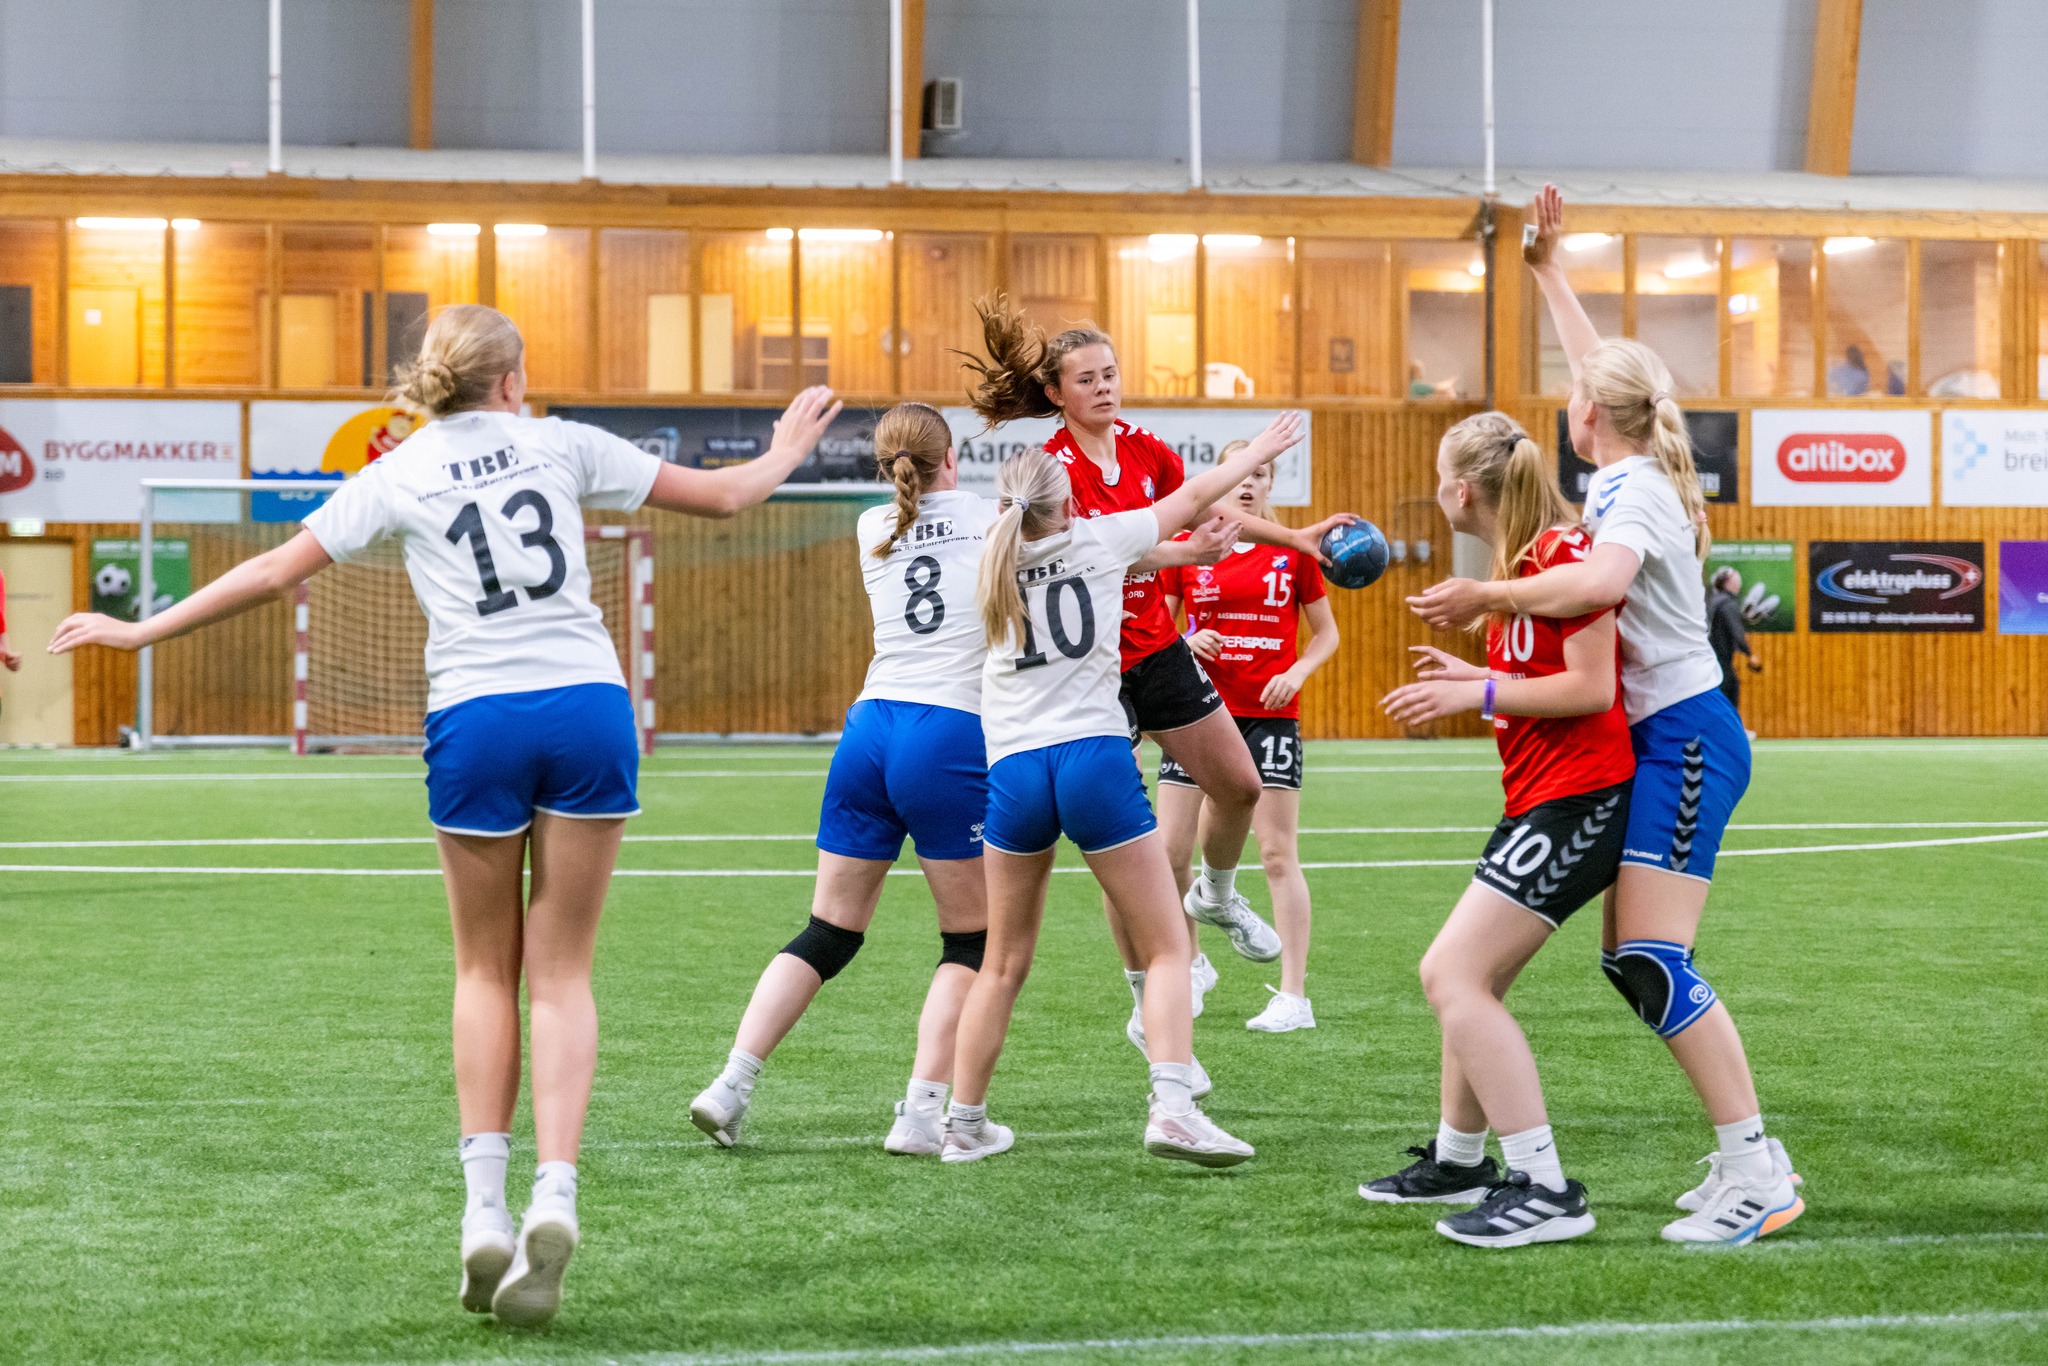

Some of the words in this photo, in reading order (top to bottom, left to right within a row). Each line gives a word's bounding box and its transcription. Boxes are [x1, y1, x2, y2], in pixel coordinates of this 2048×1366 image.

[44, 439, 218, 462] BYGGMAKKER
[442, 445, 520, 481] TBE
[1786, 440, 1895, 472] altibox
[444, 489, 567, 617] 13
[904, 555, 945, 635] 8
[1262, 571, 1293, 607] 15
[1843, 569, 1951, 593] elektropluss
[1015, 576, 1096, 671] 10
[1260, 735, 1293, 770] 15
[1491, 823, 1552, 877] 10
